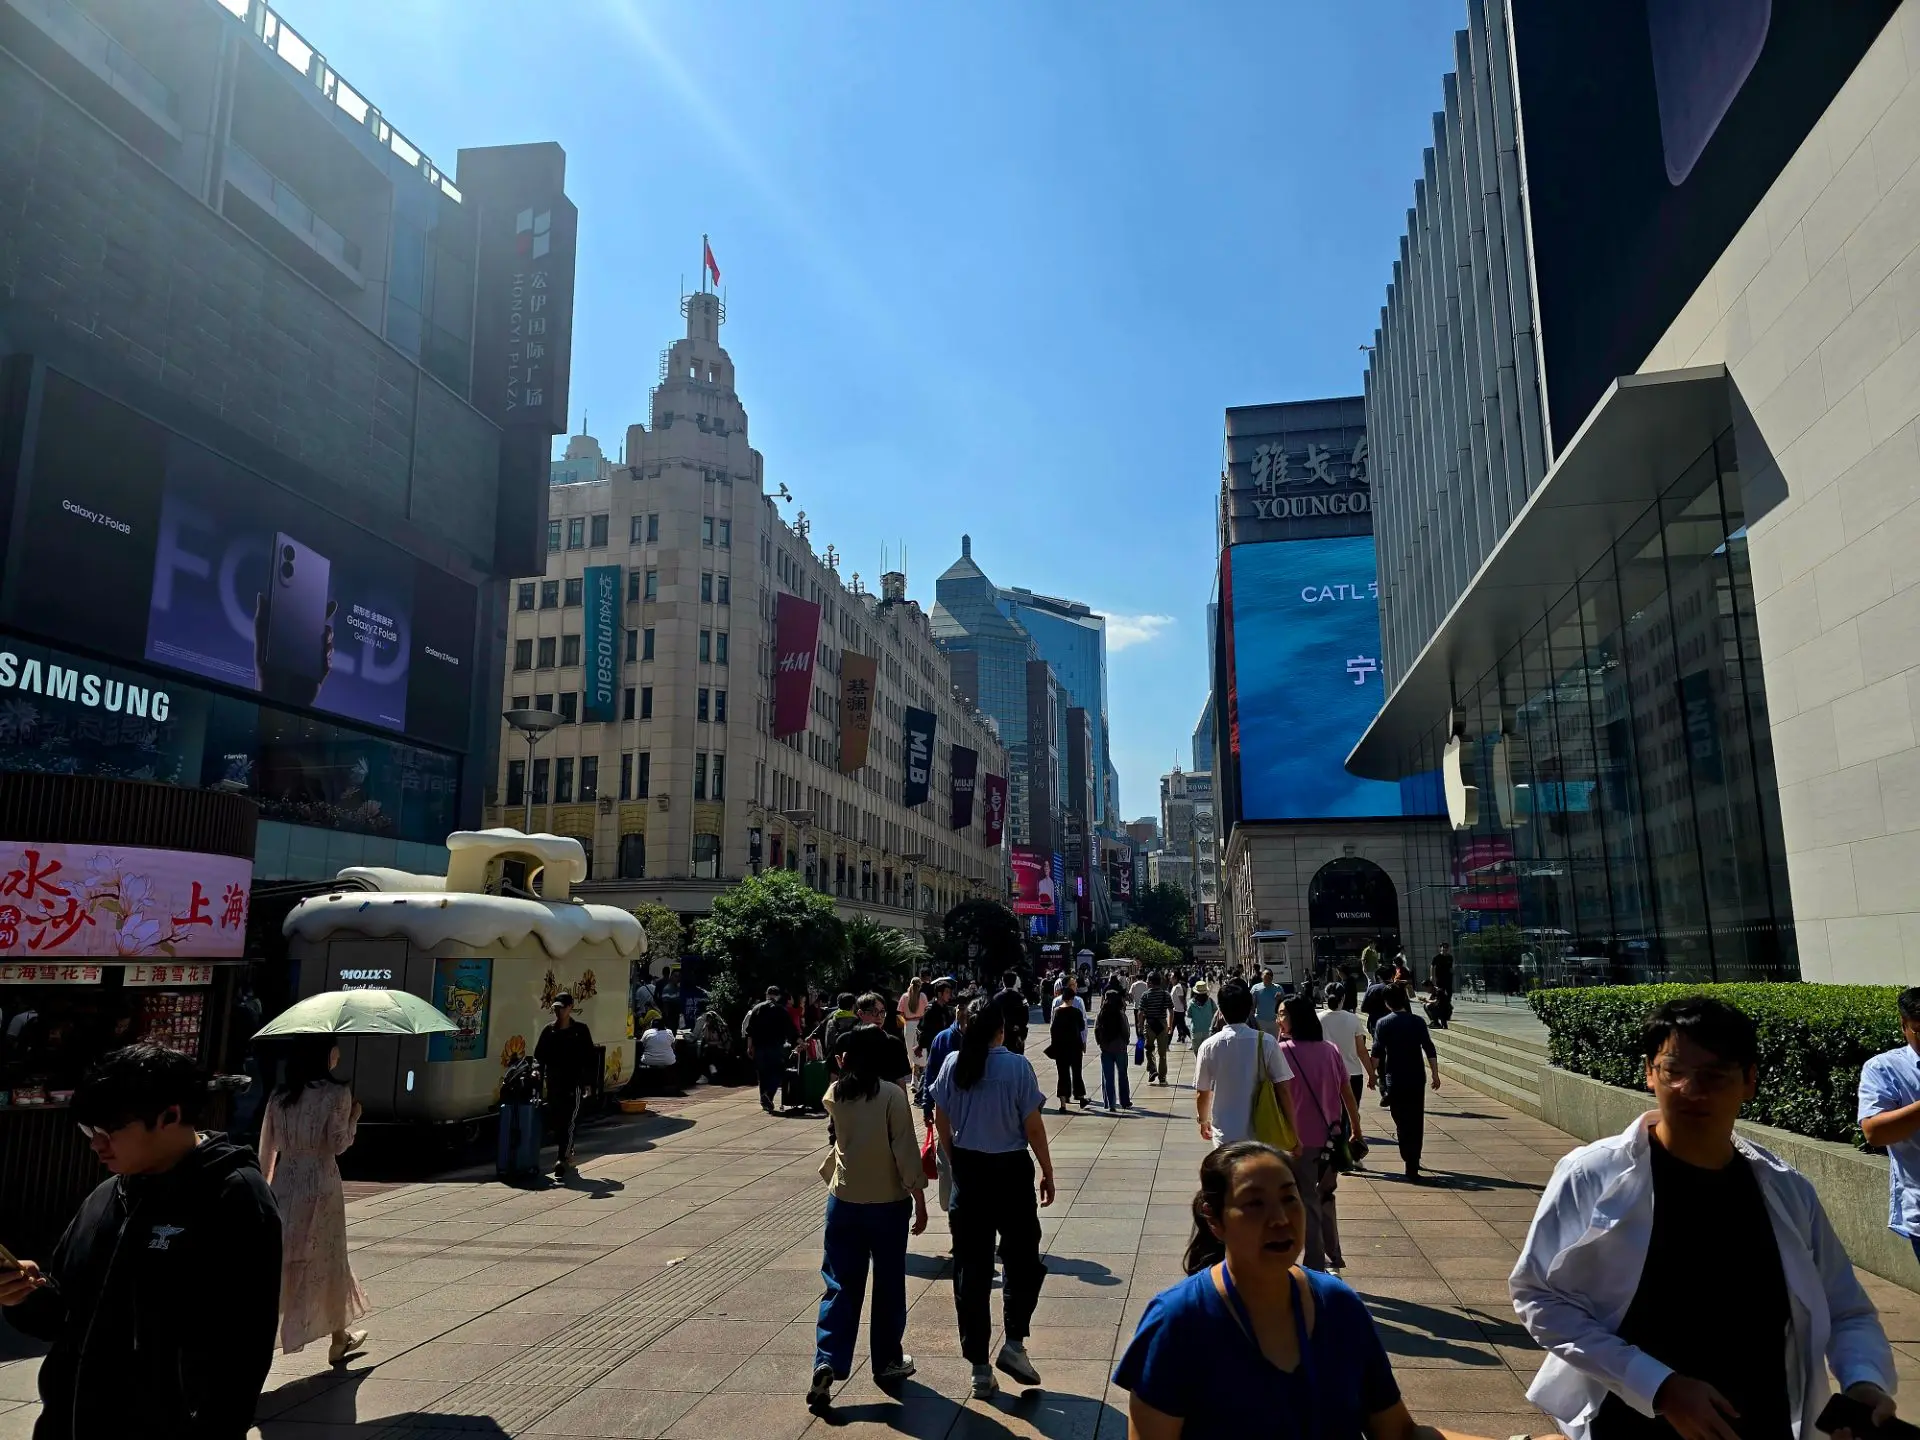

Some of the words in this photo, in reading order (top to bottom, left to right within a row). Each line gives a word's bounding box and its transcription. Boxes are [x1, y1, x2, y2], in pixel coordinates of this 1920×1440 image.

[510, 273, 524, 343] HONGYI
[526, 271, 548, 406] 宏伊国际广场
[506, 353, 519, 412] PLAZA
[62, 500, 97, 523] Galaxy
[98, 513, 105, 524] Z
[105, 515, 131, 535] Fold8
[1252, 491, 1371, 519] YOUNGO
[1301, 583, 1364, 603] CATL
[346, 615, 374, 634] Galaxy
[373, 625, 379, 635] Z
[378, 628, 398, 642] Fold8
[780, 651, 811, 672] H&M
[0, 652, 170, 722] SAMSUNG
[846, 678, 870, 712] 蔡澜
[910, 730, 928, 784] MLB
[954, 778, 975, 787] MUJI
[1120, 868, 1130, 895] KFC
[1336, 911, 1372, 919] YOUNGOR
[129, 965, 210, 983] 上海雪花膏
[340, 969, 392, 980] MOLLY'S
